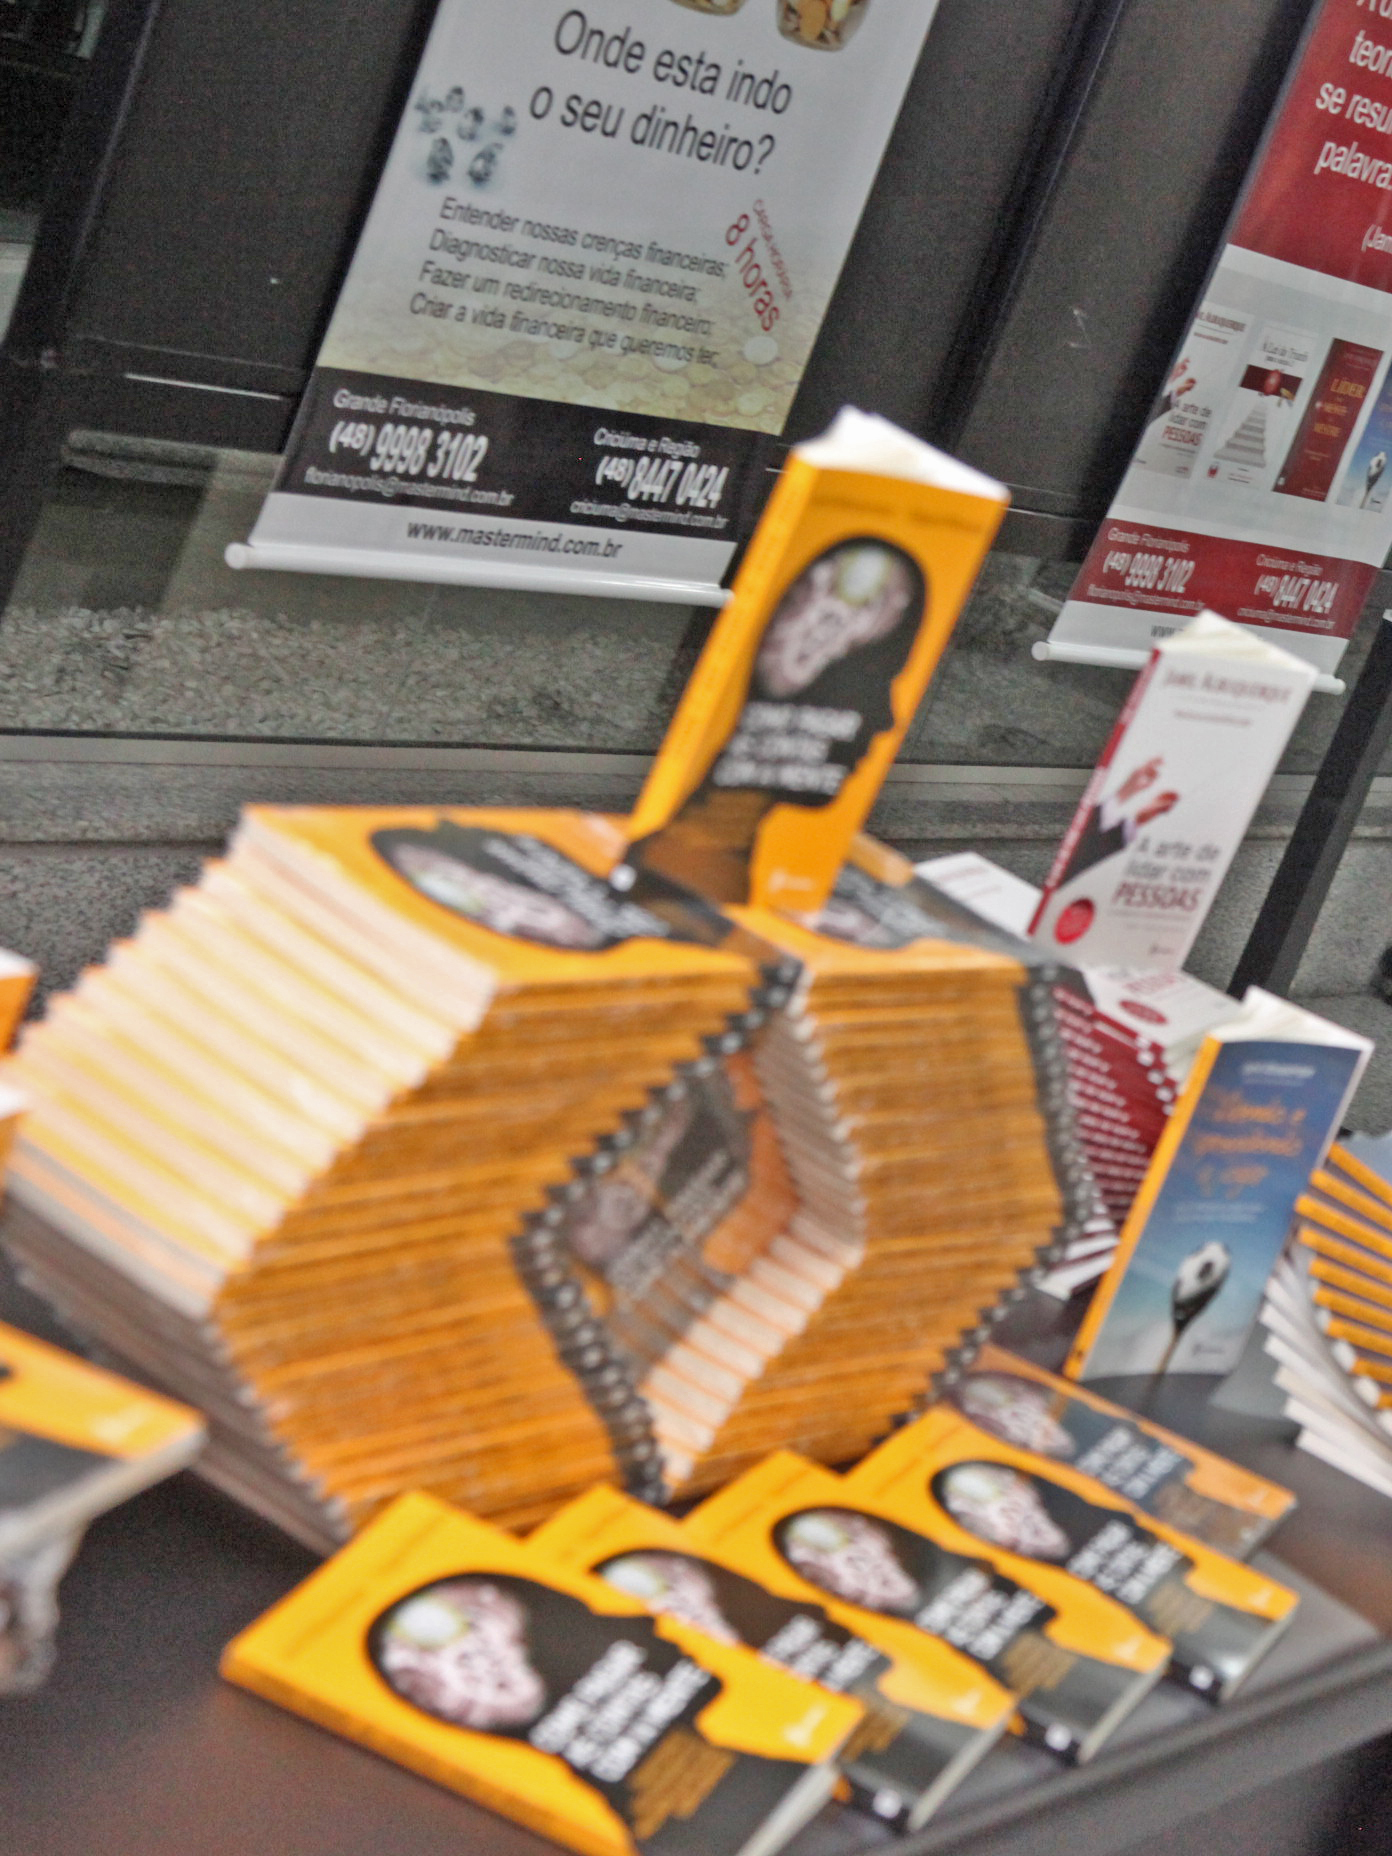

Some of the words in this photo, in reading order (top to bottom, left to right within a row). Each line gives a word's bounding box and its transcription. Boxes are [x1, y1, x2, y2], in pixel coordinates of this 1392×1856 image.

[554, 9, 646, 74] Onde
[653, 49, 722, 96] esta
[726, 59, 792, 115] indo
[1315, 81, 1347, 115] se
[529, 86, 553, 120] o
[560, 93, 625, 138] seu
[630, 104, 776, 175] dinheiro?
[428, 228, 537, 270] Diagnosticar
[537, 254, 587, 280] nossa
[588, 261, 622, 288] vida
[439, 196, 520, 233] Entender
[521, 219, 579, 246] nossas
[581, 231, 644, 262] crenças
[725, 213, 750, 246] 8
[418, 260, 472, 290] Fazer
[472, 275, 501, 296] um
[503, 280, 638, 322] redirecionamento
[735, 237, 780, 332] horas
[409, 291, 454, 320] Criar
[454, 303, 468, 323] a
[471, 303, 507, 329] vida
[509, 310, 586, 344] financeira
[588, 328, 618, 350] que
[620, 334, 695, 363] queremos
[333, 388, 388, 413] Grande
[389, 396, 477, 426] Florianópolis
[328, 420, 376, 456] (48)
[370, 422, 434, 475] 9998
[426, 429, 489, 483] 3102
[657, 436, 701, 459] Região
[595, 455, 635, 487] (48)
[627, 456, 683, 503] 8447
[676, 462, 729, 509] 0424
[406, 521, 624, 558] www.mastermind.com.br
